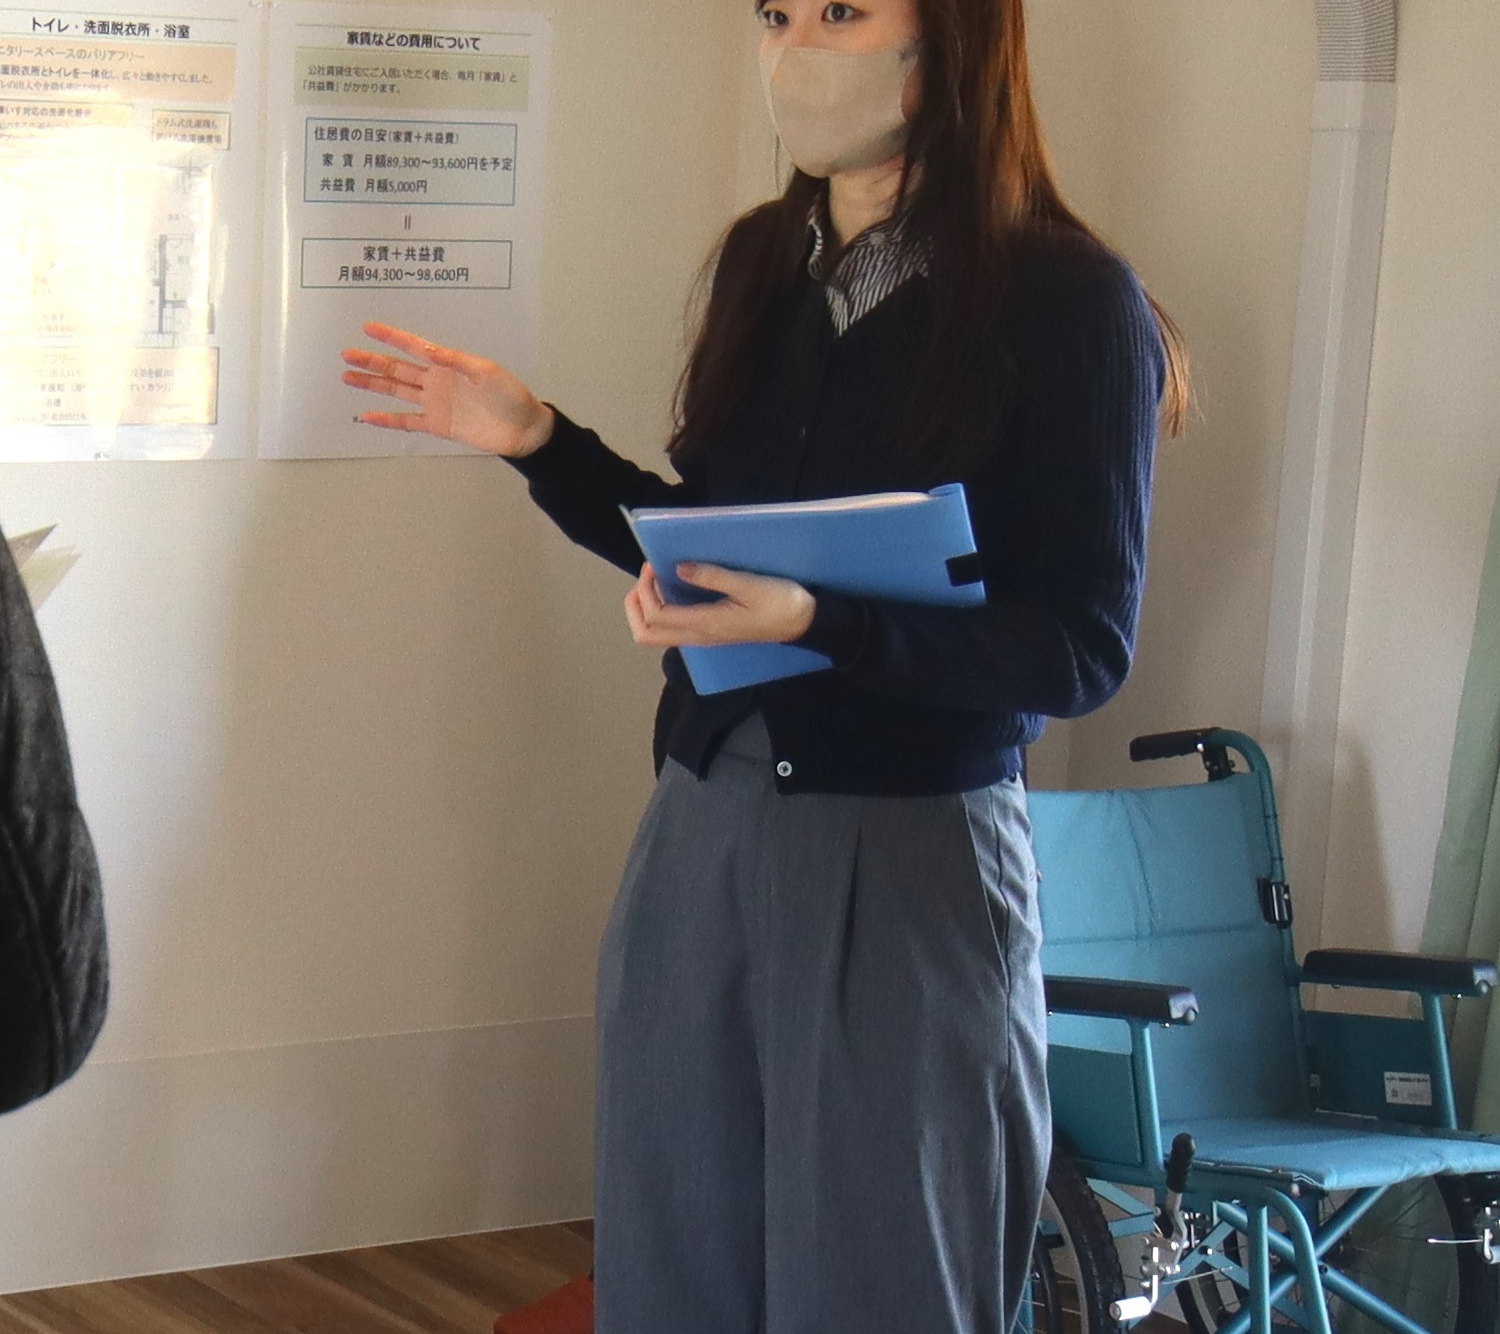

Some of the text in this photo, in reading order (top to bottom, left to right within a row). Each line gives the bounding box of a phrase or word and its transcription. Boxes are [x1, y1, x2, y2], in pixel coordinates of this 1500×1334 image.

[30, 16, 191, 39] トイレ・洗面脱衣所・浴室
[346, 31, 481, 52] 家賃などの費用について
